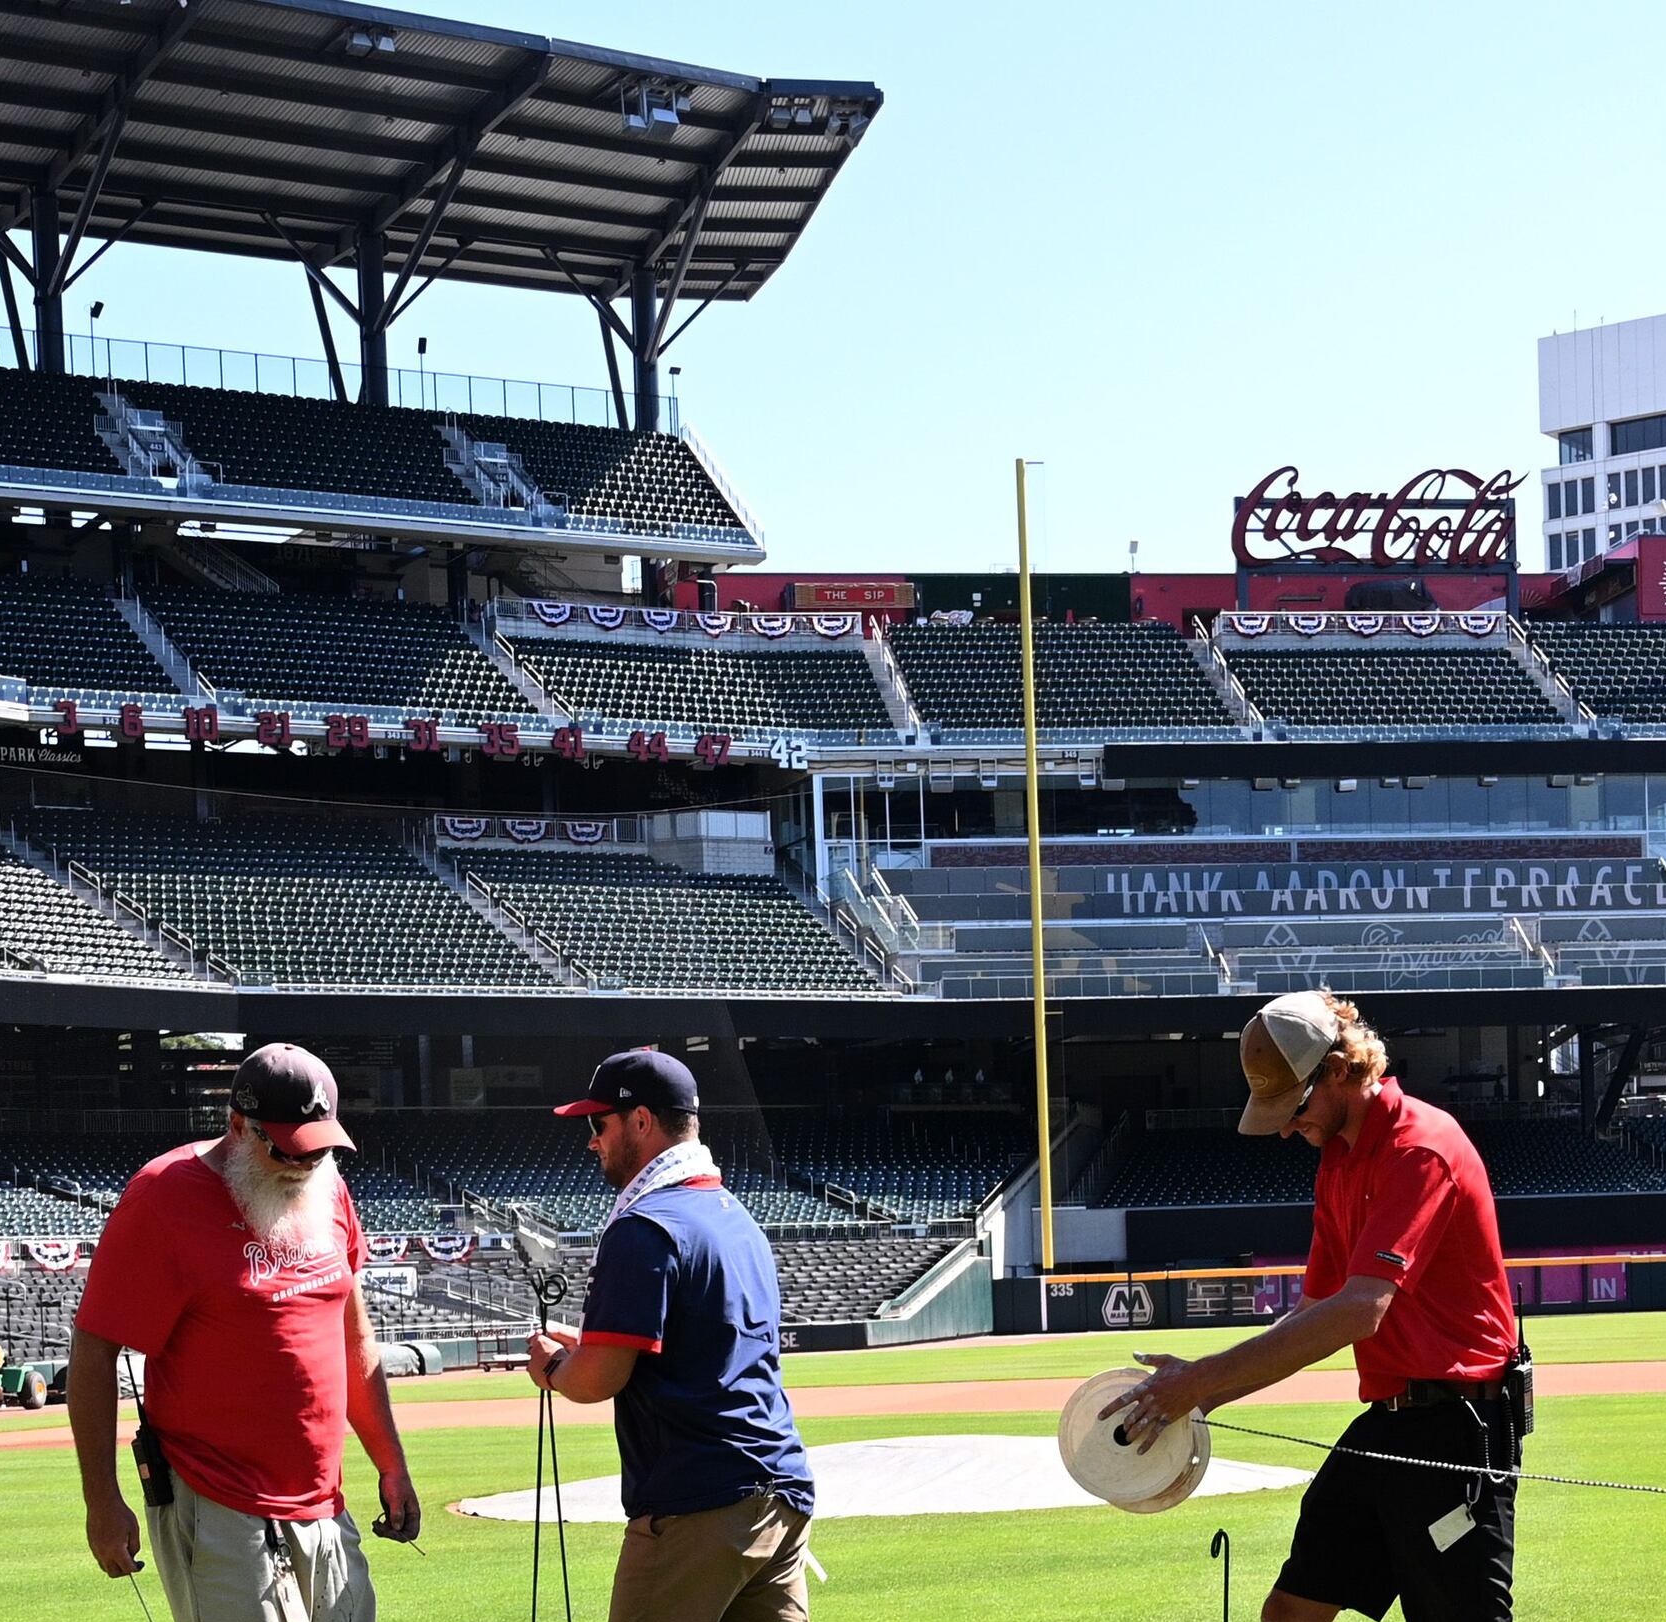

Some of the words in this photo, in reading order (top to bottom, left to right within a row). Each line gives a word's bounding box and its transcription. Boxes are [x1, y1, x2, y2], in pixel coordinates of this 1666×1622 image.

[824, 590, 847, 600] THE
[865, 590, 885, 600] SIP
[55, 700, 78, 735] 3
[122, 704, 142, 737] 6
[185, 706, 218, 741] 10
[257, 711, 292, 746] 21
[326, 715, 369, 749] 29
[408, 719, 440, 751] 31
[482, 723, 519, 756] 35
[552, 727, 584, 759] 41
[630, 732, 668, 763] 44
[696, 735, 730, 766] 47
[37, 749, 82, 764] Classics
[770, 735, 808, 769] 42
[1107, 871, 1244, 914] HANK
[1256, 868, 1431, 912] AARON
[1050, 1284, 1074, 1297] 335
